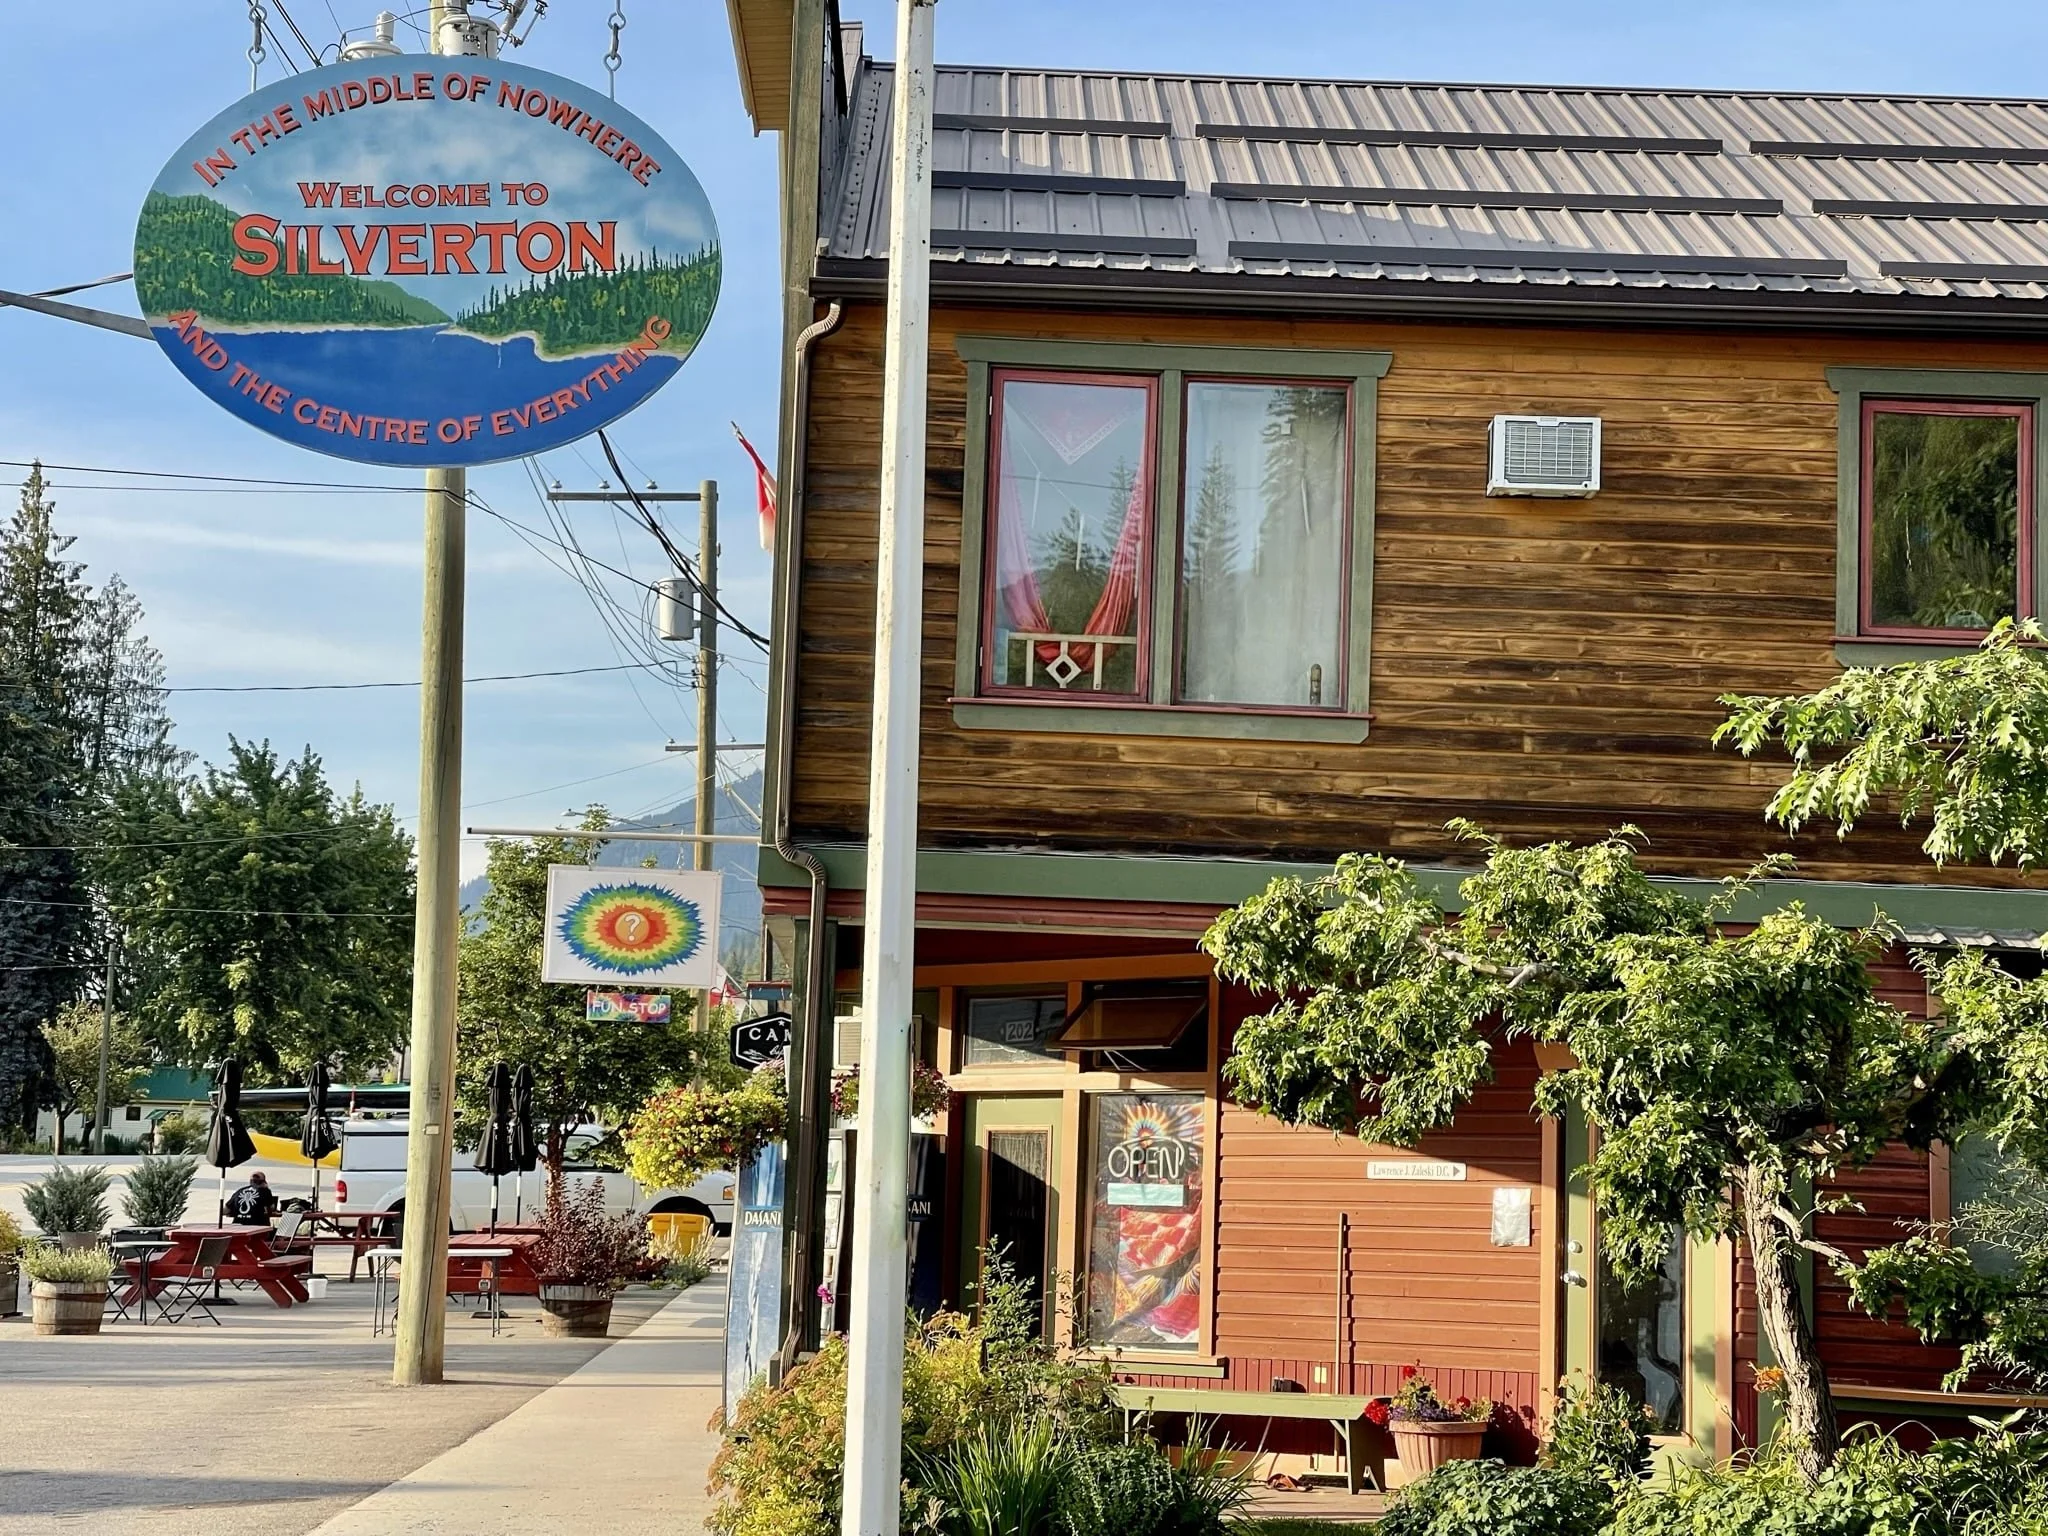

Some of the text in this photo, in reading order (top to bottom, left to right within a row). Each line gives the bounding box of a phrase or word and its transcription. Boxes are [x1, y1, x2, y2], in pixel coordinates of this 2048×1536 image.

[192, 72, 662, 188] IN THE MIDDLE OF NOWHERE
[297, 181, 549, 209] WELCOME TO
[231, 213, 618, 277] SILVERTON
[168, 309, 674, 445] AND THE CENTRE OF EVERYTHING
[592, 999, 667, 1015] FUN STOP
[1007, 1023, 1033, 1040] 202
[1107, 1145, 1180, 1179] OPEN
[1373, 1164, 1404, 1177] Lawrence
[1411, 1165, 1434, 1177] Zaleski
[1436, 1165, 1450, 1177] D.C.
[744, 1210, 782, 1227] DASANI
